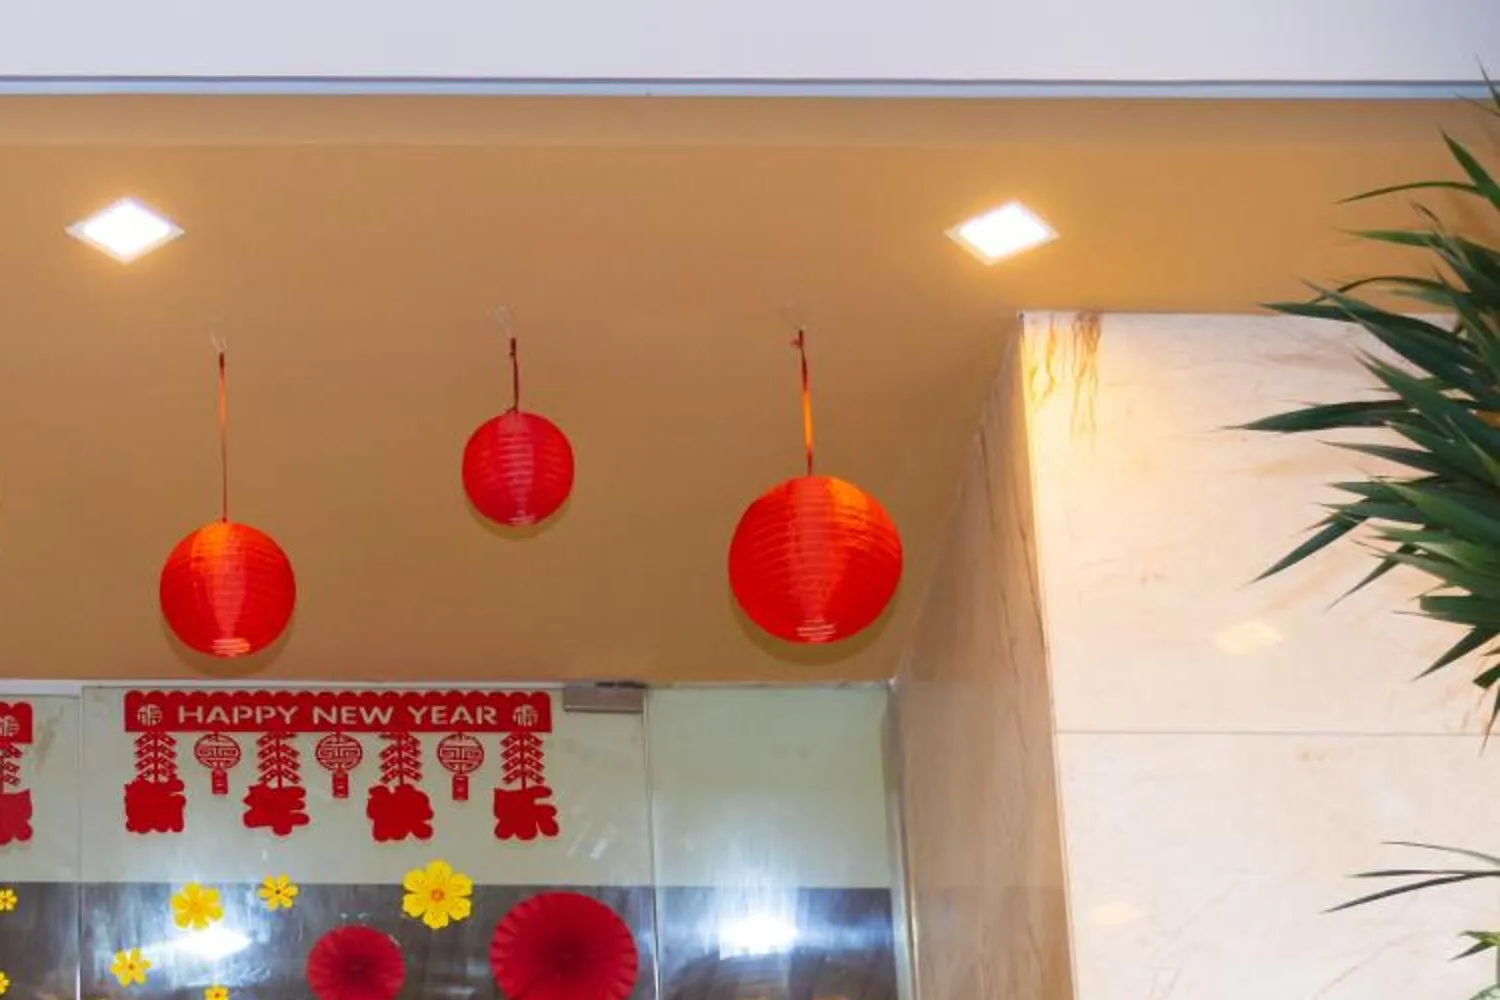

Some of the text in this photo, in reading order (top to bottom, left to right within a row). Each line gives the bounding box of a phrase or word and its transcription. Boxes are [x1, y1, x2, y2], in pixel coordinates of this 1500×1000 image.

[178, 704, 498, 726] HAPPY NEW YEAR
